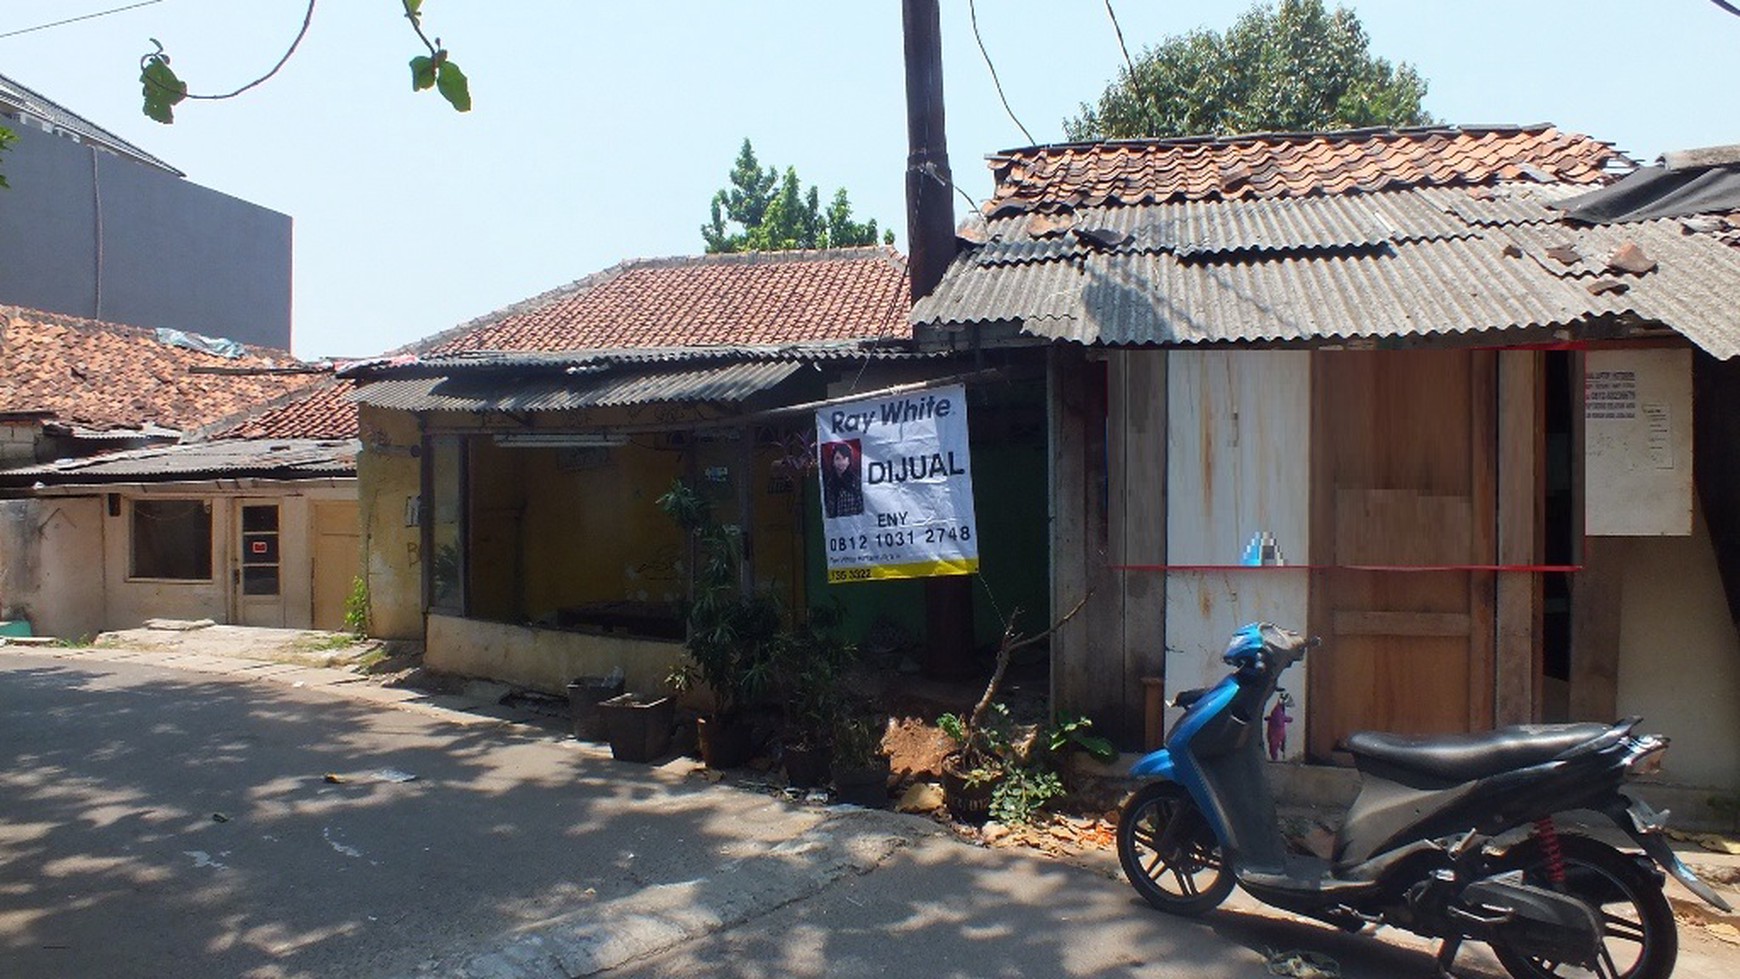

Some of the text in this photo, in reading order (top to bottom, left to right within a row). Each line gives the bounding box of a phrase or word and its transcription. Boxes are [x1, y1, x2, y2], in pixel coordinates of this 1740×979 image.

[832, 396, 951, 434] Ray White
[868, 452, 965, 485] DIJUAL
[878, 512, 908, 527] ENY
[830, 527, 970, 551] 0812 1031 2748
